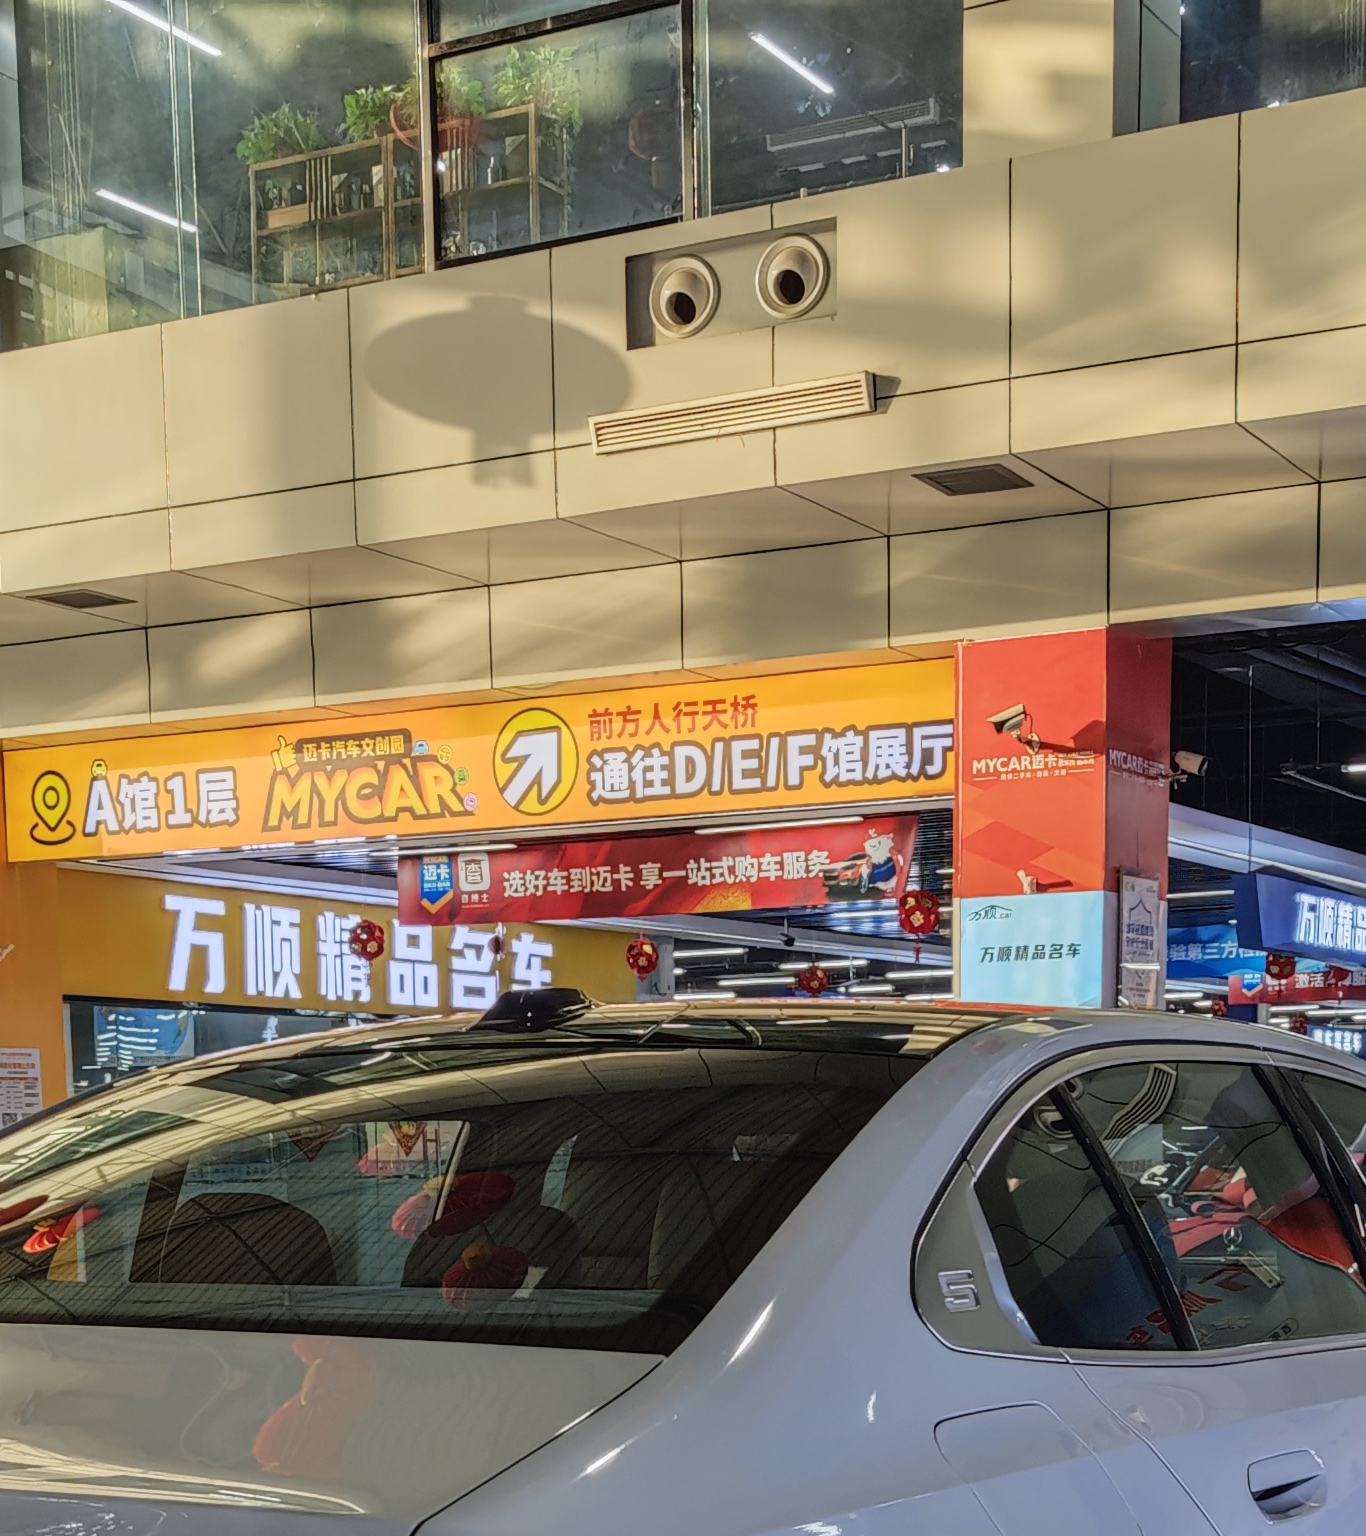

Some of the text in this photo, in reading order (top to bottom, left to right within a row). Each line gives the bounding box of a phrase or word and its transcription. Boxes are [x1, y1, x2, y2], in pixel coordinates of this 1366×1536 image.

[588, 694, 758, 742] 前方人行天桥
[301, 734, 406, 763] 迈卡汽车文创园
[589, 722, 954, 803] 通往D/E/F馆展厅
[83, 770, 238, 836] A馆1层
[265, 759, 468, 829] MYCAR
[423, 864, 450, 881] 迈卡
[502, 849, 832, 898] 选好车到迈卡 享一站式购车服务
[162, 893, 555, 1008] 万顺精品名车
[979, 942, 1082, 964] 万顺精品名车
